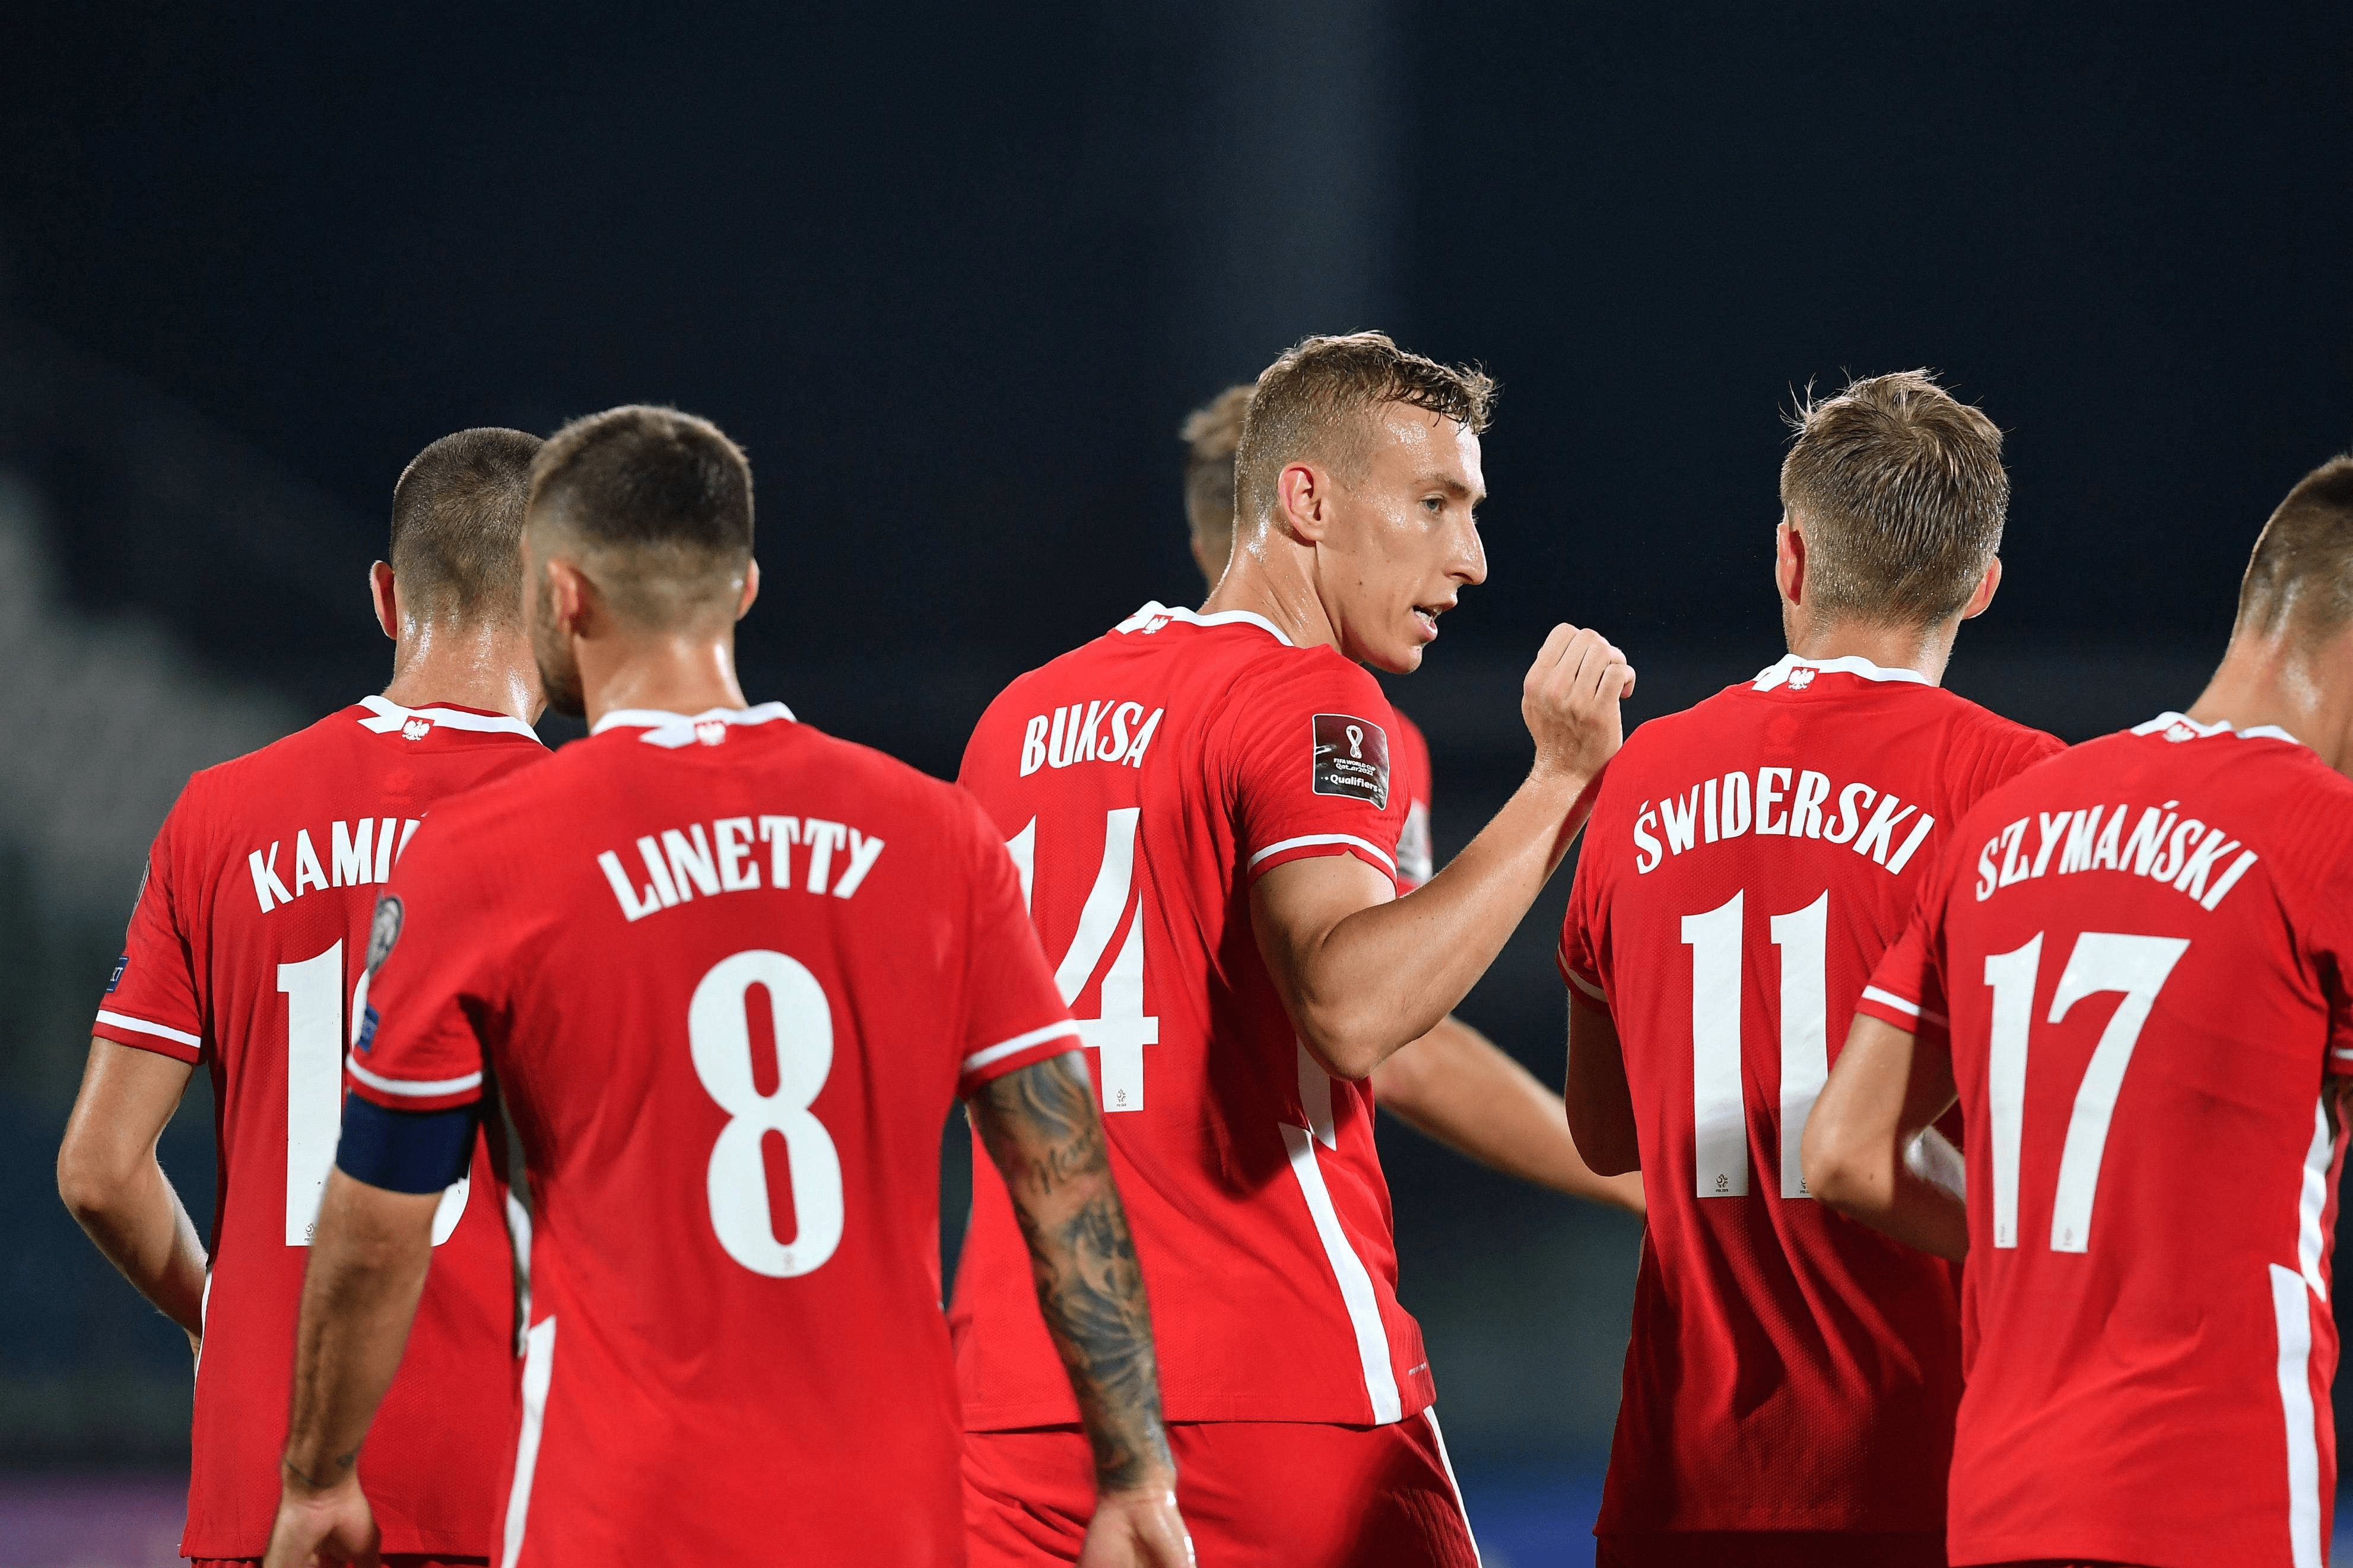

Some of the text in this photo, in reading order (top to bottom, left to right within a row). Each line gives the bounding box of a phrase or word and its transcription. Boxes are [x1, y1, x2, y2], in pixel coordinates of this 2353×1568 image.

[1020, 700, 1164, 777] BUKSA
[1330, 774, 1377, 792] Qualifiers
[1346, 759, 1366, 768] WORLD
[248, 811, 427, 914] KAMI
[597, 815, 885, 922] LINETTY
[1633, 766, 1935, 875] ŚWIDERSKI
[1976, 800, 2258, 911] SZYMAŃSKI
[277, 938, 471, 1247] 1
[1681, 888, 1829, 1198] 11
[1983, 931, 2190, 1254] 17
[688, 949, 844, 1278] 8
